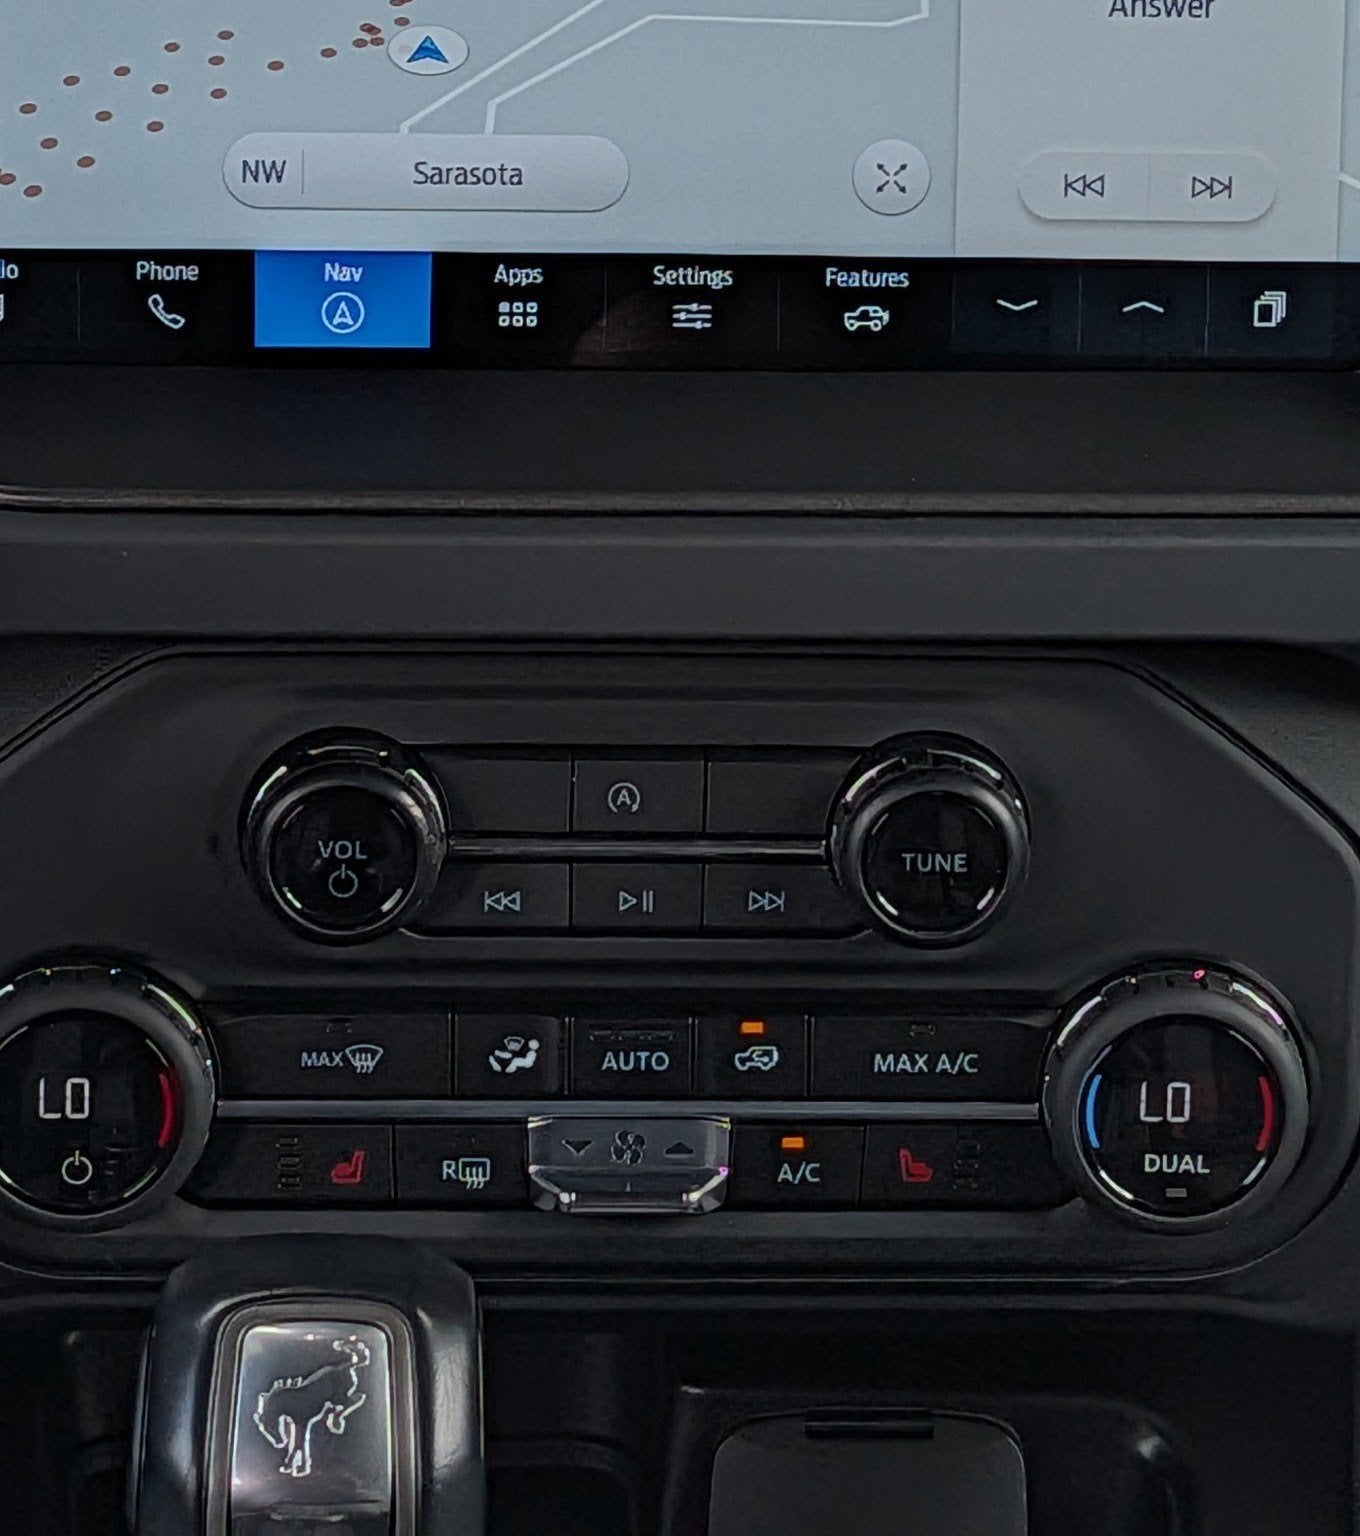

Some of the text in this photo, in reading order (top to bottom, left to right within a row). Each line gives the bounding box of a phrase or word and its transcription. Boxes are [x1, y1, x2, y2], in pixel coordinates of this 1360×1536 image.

[241, 160, 286, 184] NW
[413, 162, 523, 186] Sarasota
[136, 261, 199, 282] Phone
[324, 263, 363, 283] Nav
[494, 265, 544, 287] Apps
[653, 266, 733, 289] Settings
[825, 267, 909, 289] Features
[318, 840, 368, 860] VOL
[901, 853, 968, 873] TUNE
[301, 1051, 344, 1068] MAX
[601, 1051, 670, 1072] AUTO
[874, 1053, 979, 1075] MAX A/C
[443, 1162, 456, 1180] R
[777, 1162, 821, 1184] A/C
[1143, 1154, 1211, 1174] DUAL
